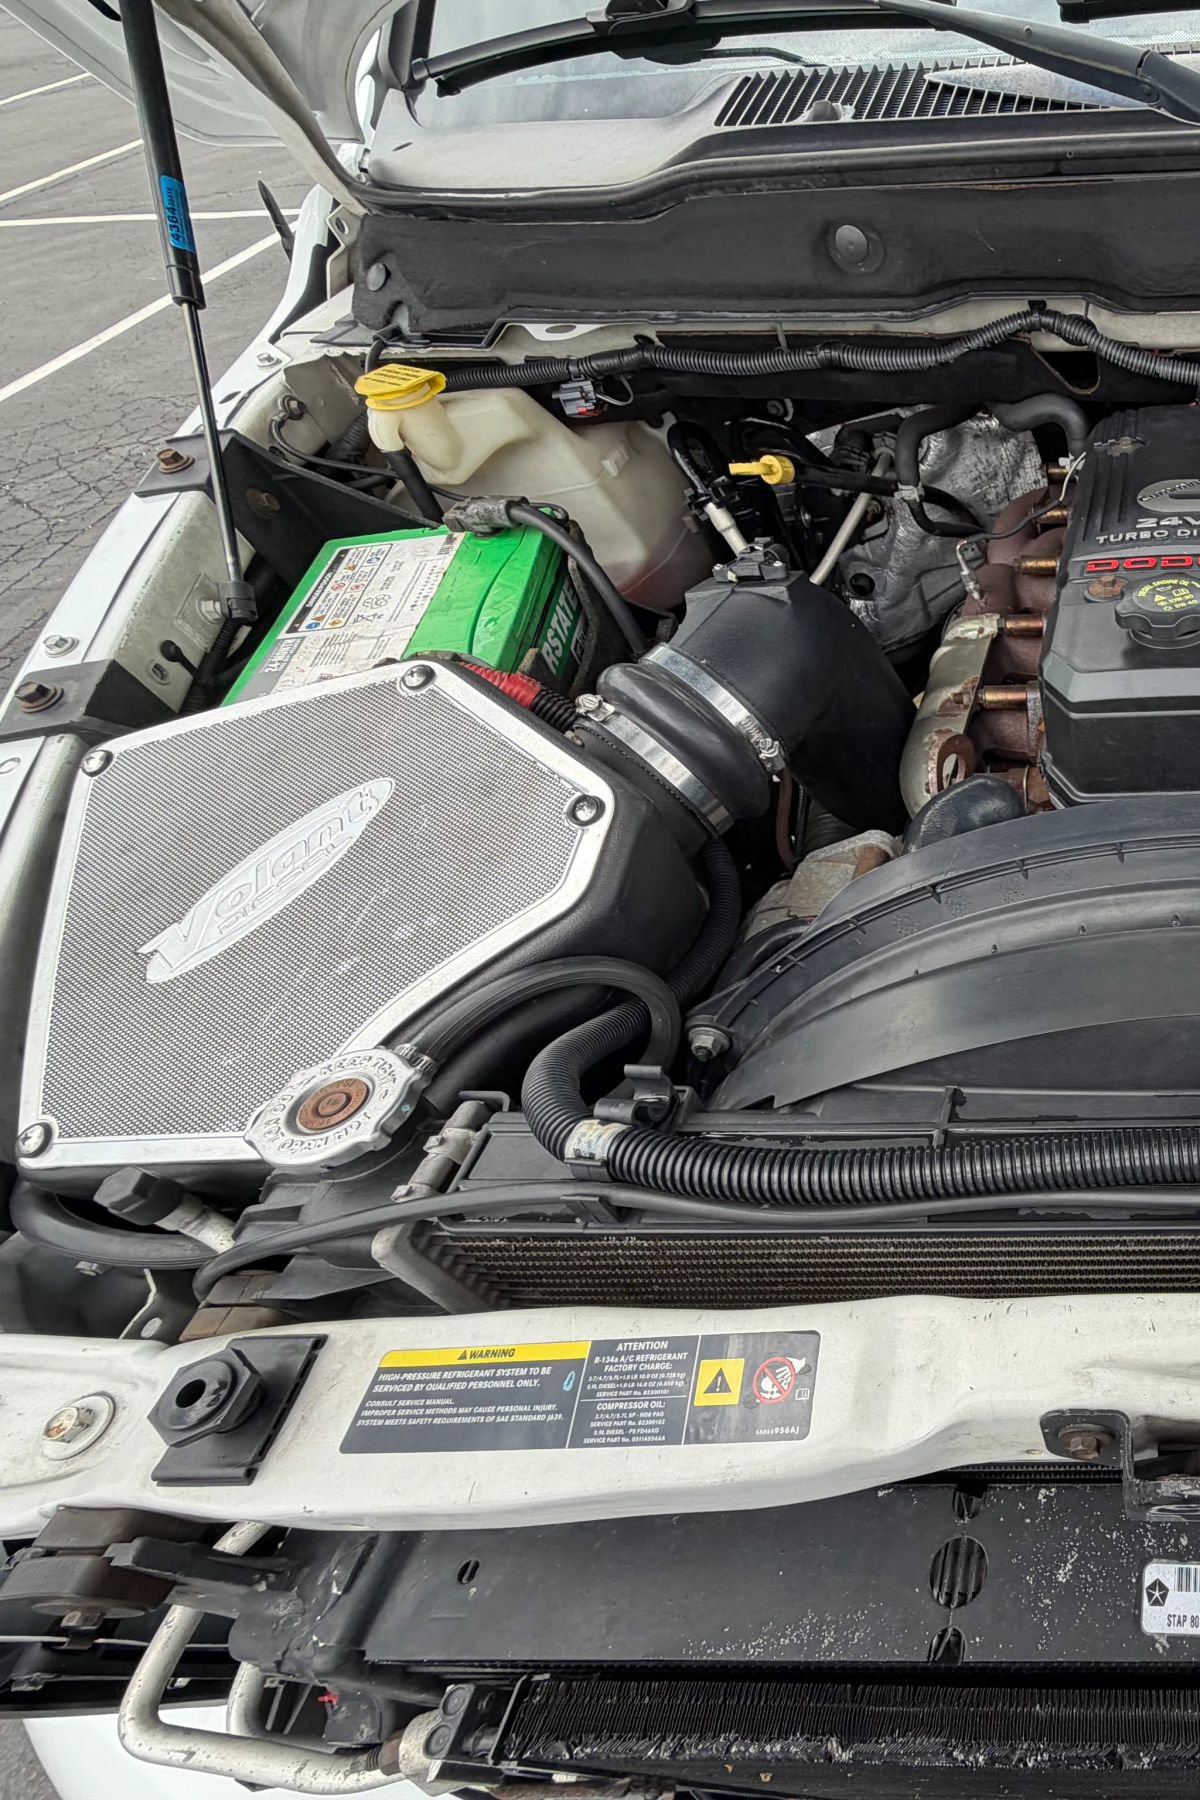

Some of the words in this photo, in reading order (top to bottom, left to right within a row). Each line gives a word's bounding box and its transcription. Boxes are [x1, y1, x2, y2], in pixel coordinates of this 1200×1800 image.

[1096, 529, 1168, 544] TURBO
[616, 1341, 668, 1352] ATTENTION
[469, 1348, 515, 1360] WARNING
[620, 1354, 635, 1363] A/C
[635, 1352, 688, 1362] REFRIGERANT
[378, 1371, 442, 1381] HIGH-PRESSURE
[442, 1368, 495, 1379] REFRIGERANT
[495, 1367, 528, 1377] SYSTEM
[528, 1367, 540, 1375] TO
[540, 1366, 552, 1375] BE
[604, 1364, 637, 1373] FACTORY
[638, 1362, 673, 1371] CHARGE:
[372, 1384, 413, 1393] SERVICED
[413, 1383, 426, 1392] BY
[425, 1381, 467, 1391] QUALIFIED
[467, 1380, 515, 1390] PERSONNEL
[516, 1378, 541, 1387] ONLY.
[397, 1399, 425, 1407] SERVICE
[425, 1398, 454, 1406] MANUAL.
[596, 1401, 650, 1411] COMPRESSOR
[650, 1400, 666, 1409] OIL:
[361, 1409, 396, 1417] IMPROPER
[396, 1408, 425, 1416] SERVICE
[425, 1407, 457, 1415] METHODS
[473, 1406, 496, 1414] CAUSE
[496, 1405, 531, 1413] PERSONAL
[532, 1404, 557, 1412] INJURY.
[356, 1418, 385, 1426] SYSTEM
[384, 1418, 407, 1426] MEETS
[407, 1417, 433, 1425] SAFETY
[432, 1416, 486, 1425] REQUIREMENTS
[485, 1415, 496, 1423] OF
[496, 1415, 510, 1423] SAE
[510, 1414, 547, 1422] STANDARD
[1167, 1614, 1187, 1628] STAP
